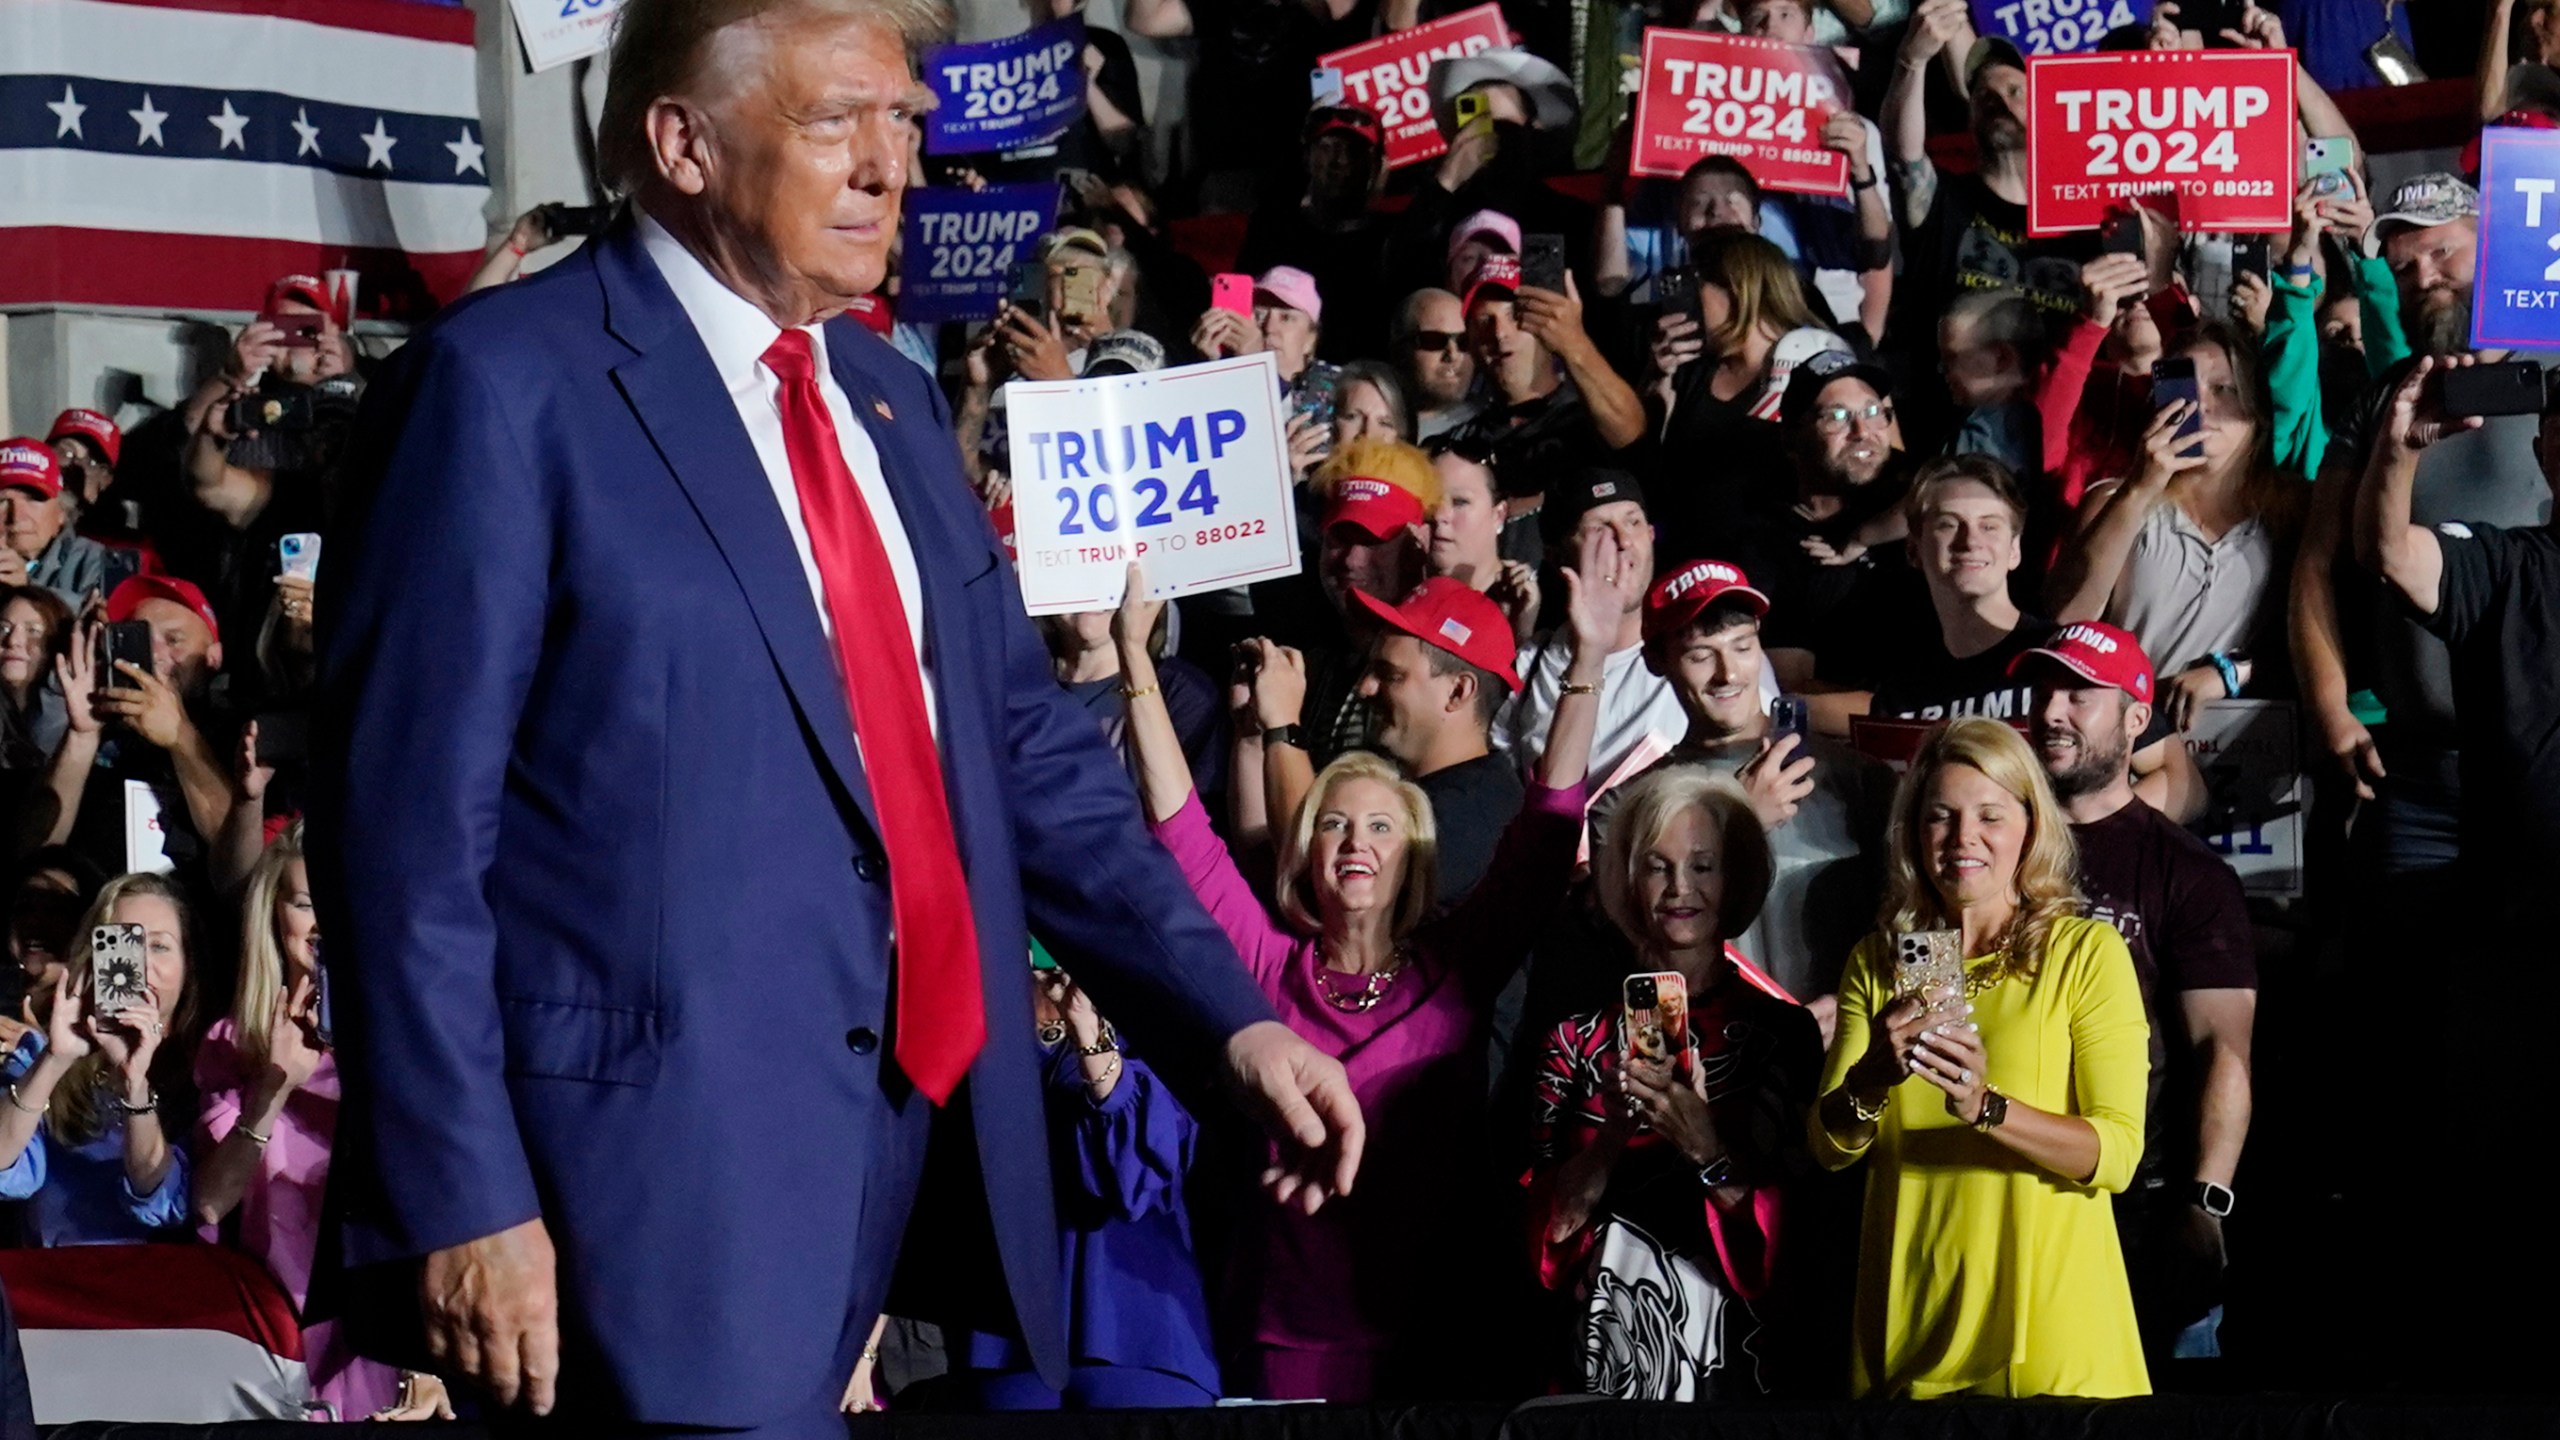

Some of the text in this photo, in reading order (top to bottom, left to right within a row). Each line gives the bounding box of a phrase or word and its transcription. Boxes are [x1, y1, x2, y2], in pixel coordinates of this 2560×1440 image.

[1994, 0, 2098, 36] TRU
[2025, 0, 2136, 55] 2024
[942, 40, 1075, 93] TRUMP
[1664, 58, 1834, 108] TRUMP
[964, 73, 1061, 119] 2024
[1375, 87, 1431, 128] 20
[2055, 86, 2270, 132] TRUMP
[1682, 98, 1807, 143] 2024
[1654, 134, 1693, 151] TEXT
[1698, 139, 1754, 157] TRUMP
[1759, 144, 1779, 160] TO
[2086, 130, 2239, 176] 2024
[2052, 180, 2274, 200] TEXT TRUMP TO 88022
[918, 210, 1041, 245] TRUMP
[930, 244, 1016, 279] 2024
[2503, 288, 2560, 309] TEXT
[1028, 409, 1246, 481] TRUMP
[1056, 468, 1220, 536] 2024
[1036, 548, 1072, 568] TEXT
[1157, 534, 1187, 554] TO
[1195, 519, 1266, 546] 88022
[1665, 563, 1738, 600] TRUMP
